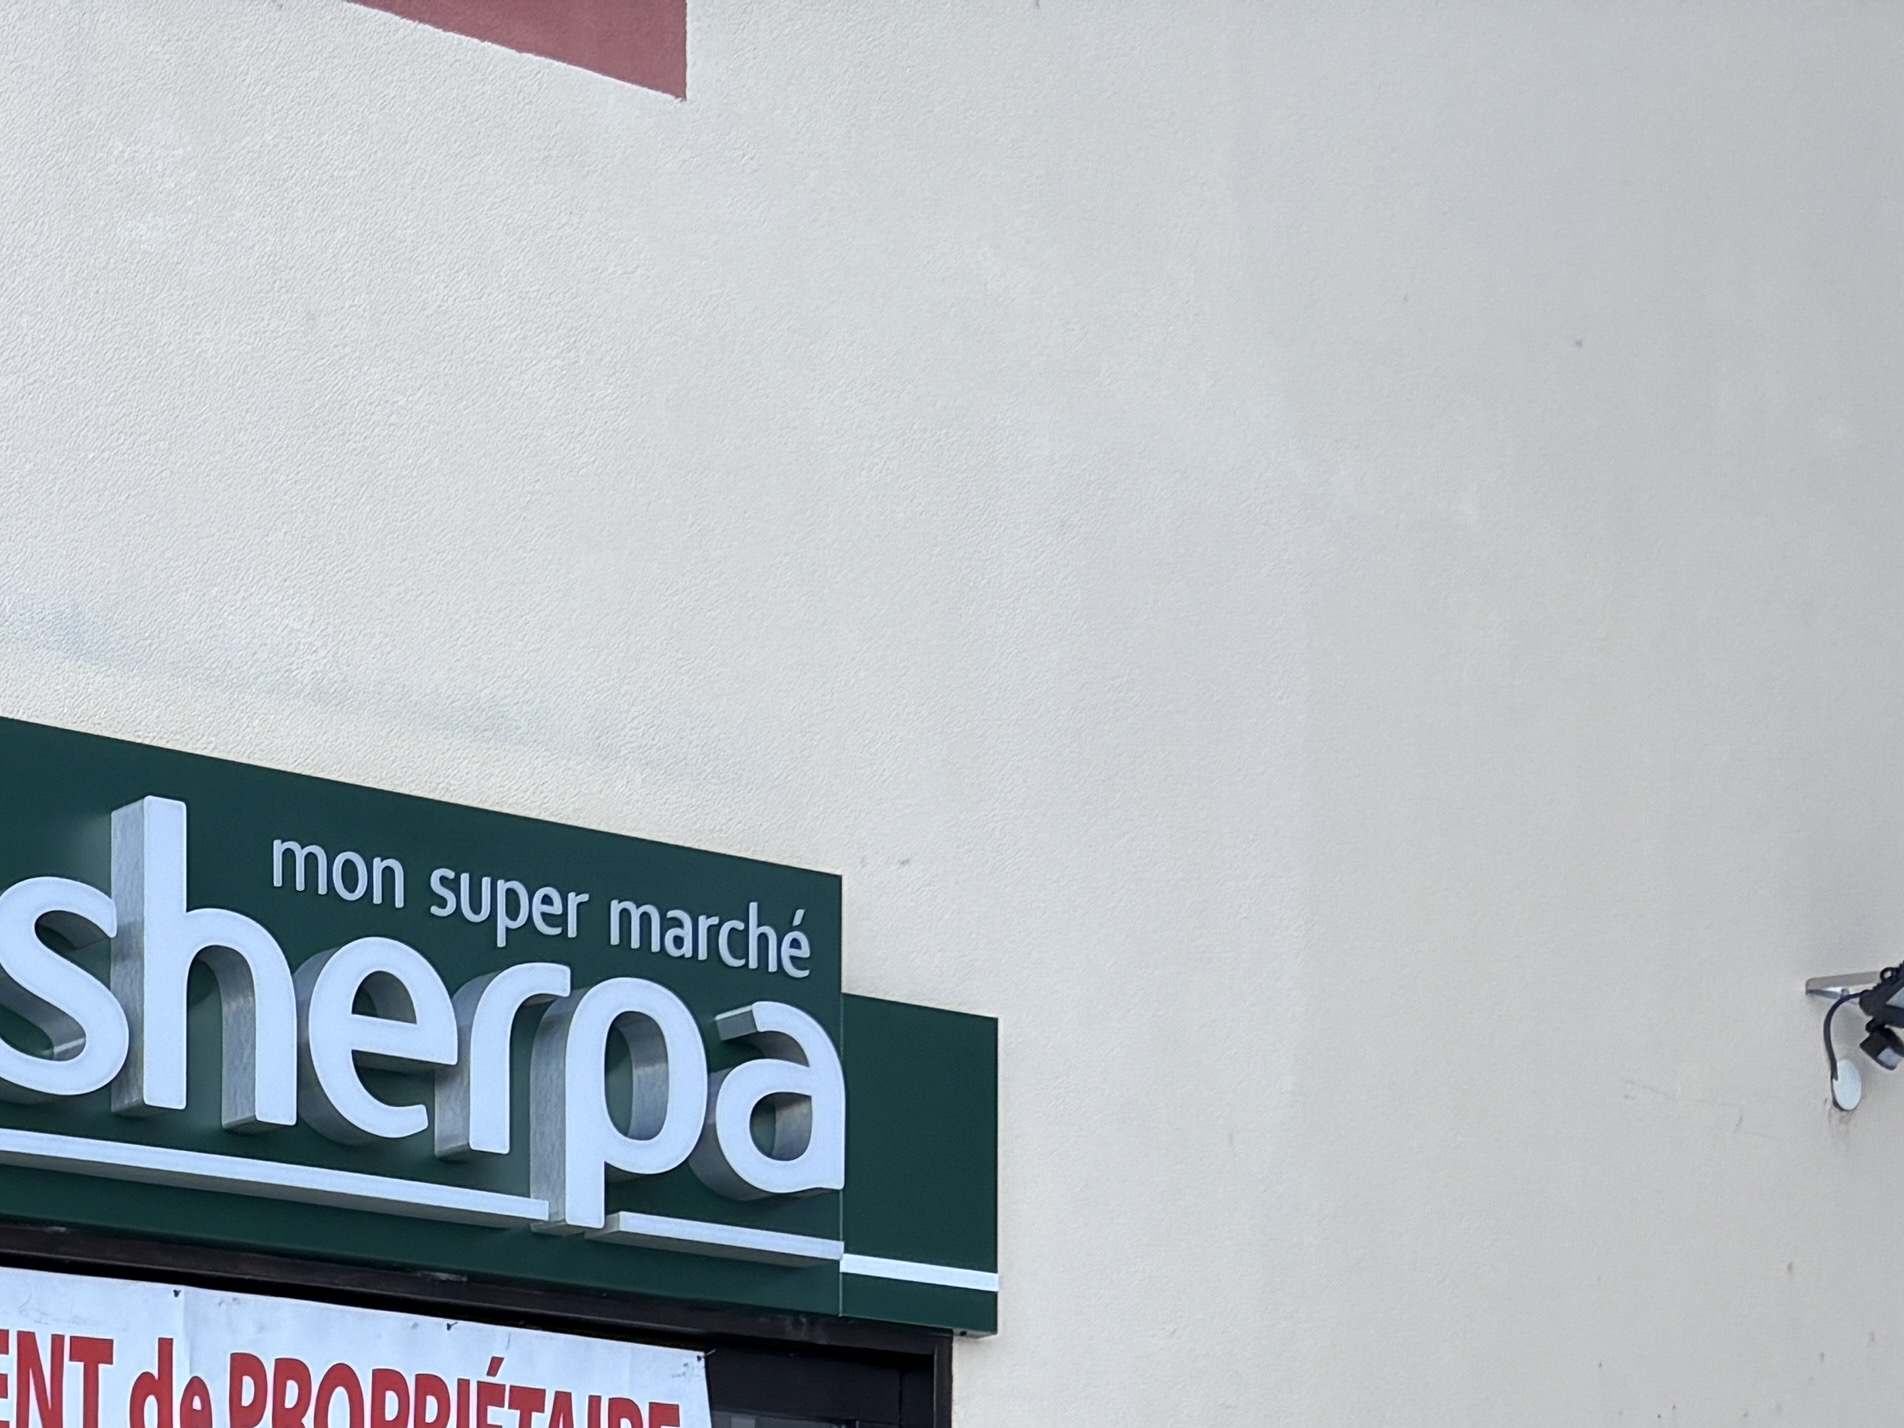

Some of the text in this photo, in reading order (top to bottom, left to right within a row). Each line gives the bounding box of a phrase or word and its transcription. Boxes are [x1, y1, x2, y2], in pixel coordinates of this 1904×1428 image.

[271, 837, 810, 978] mon super marché
